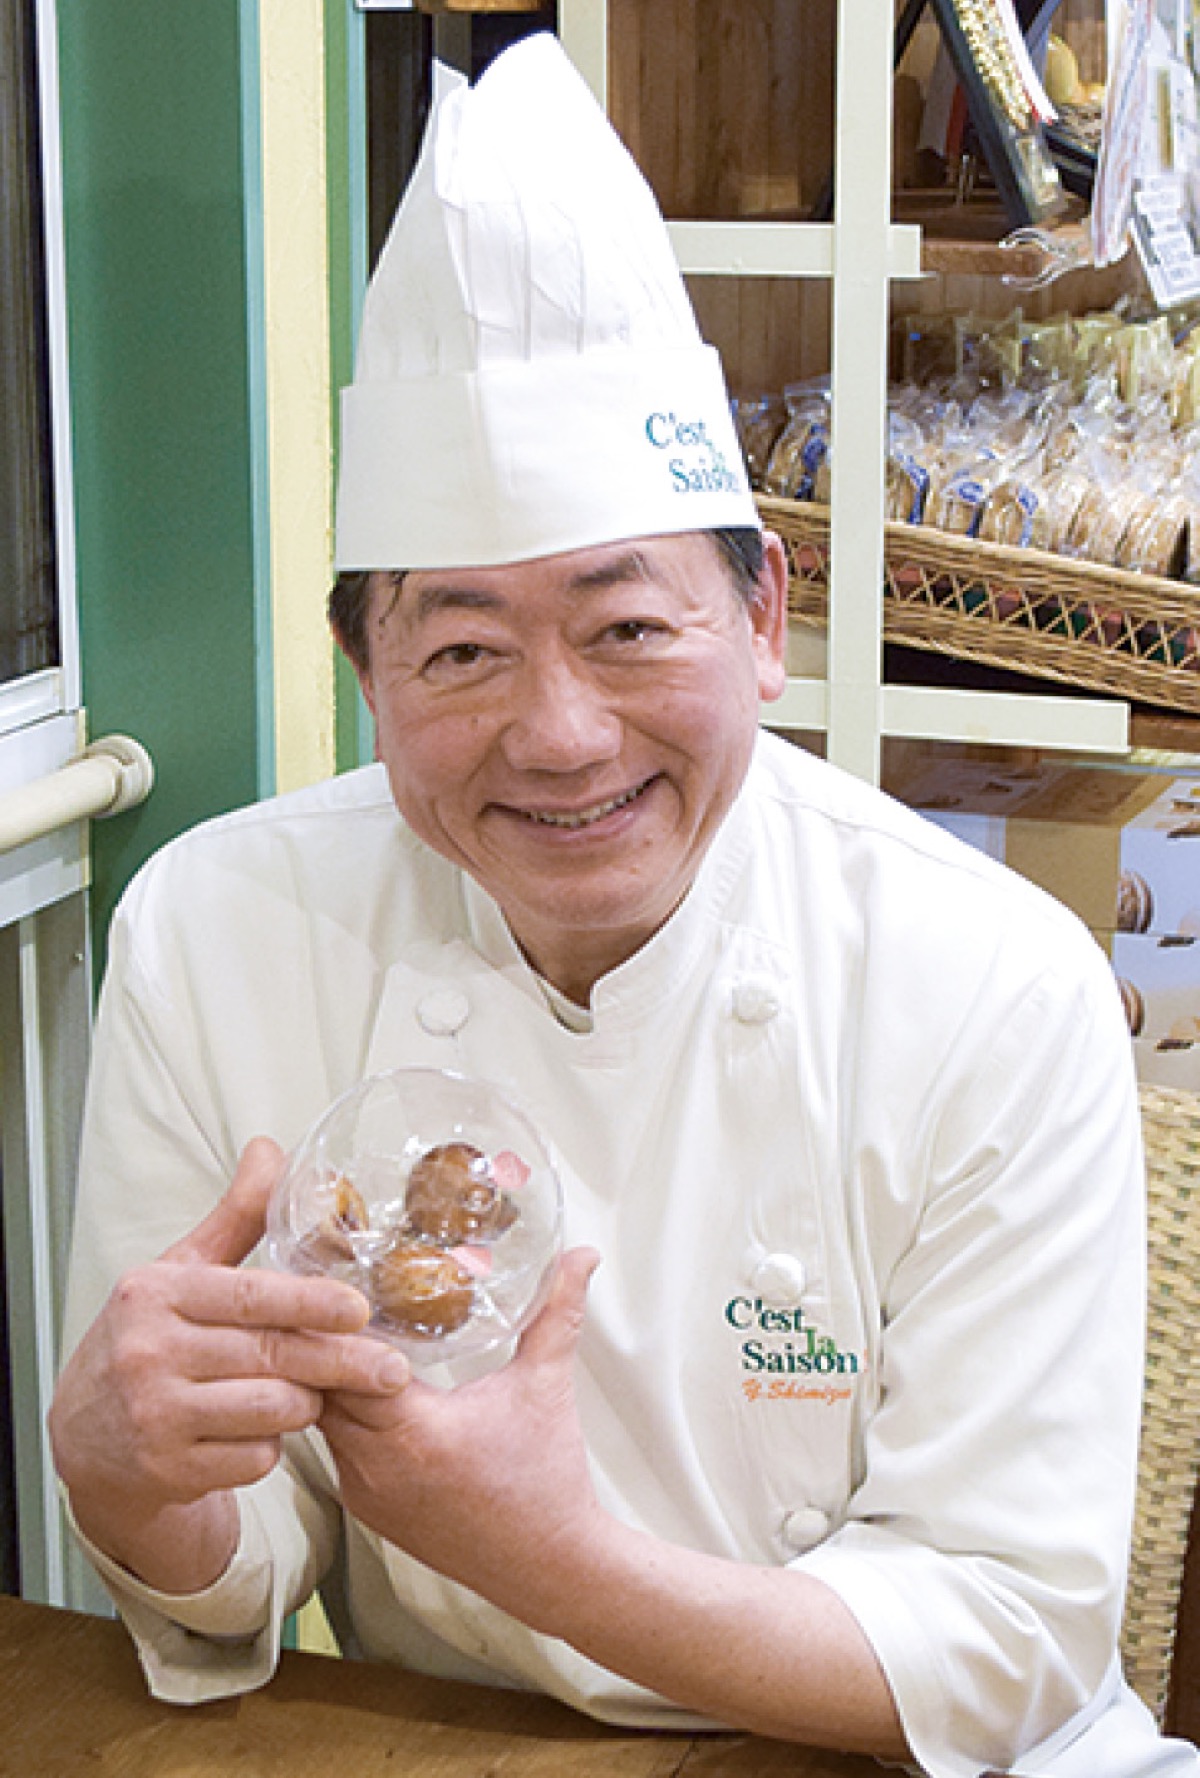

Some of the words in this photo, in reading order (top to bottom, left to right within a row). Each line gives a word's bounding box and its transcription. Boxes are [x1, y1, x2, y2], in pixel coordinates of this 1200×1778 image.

[645, 412, 706, 449] C'est
[725, 1296, 804, 1333] C'est
[804, 1327, 836, 1357] la
